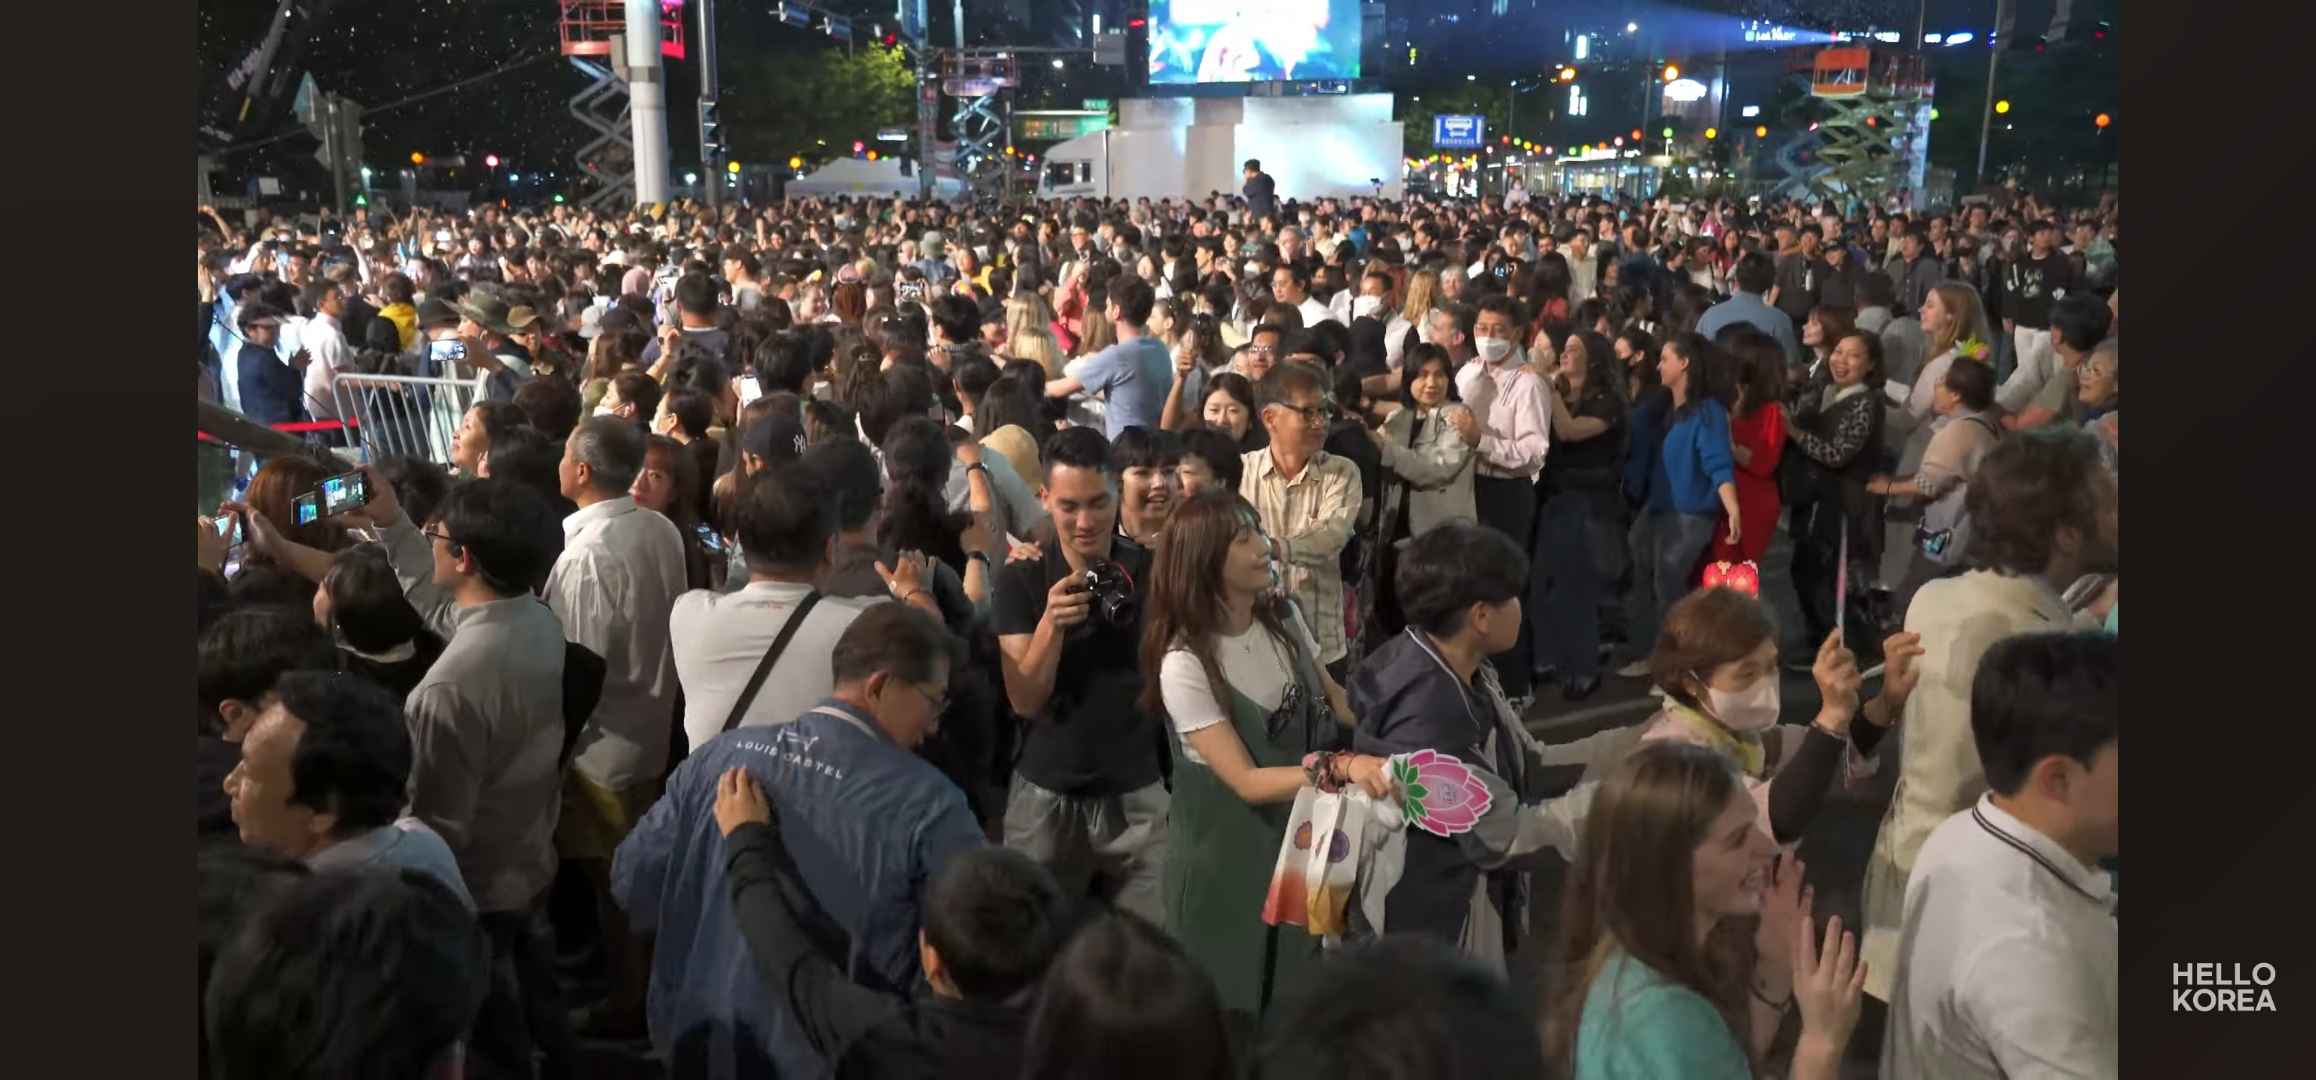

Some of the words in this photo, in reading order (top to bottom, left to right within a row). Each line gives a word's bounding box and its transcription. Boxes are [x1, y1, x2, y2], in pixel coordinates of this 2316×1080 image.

[793, 434, 807, 454] NY
[736, 740, 778, 757] LOUIS
[783, 752, 843, 779] CASTEL
